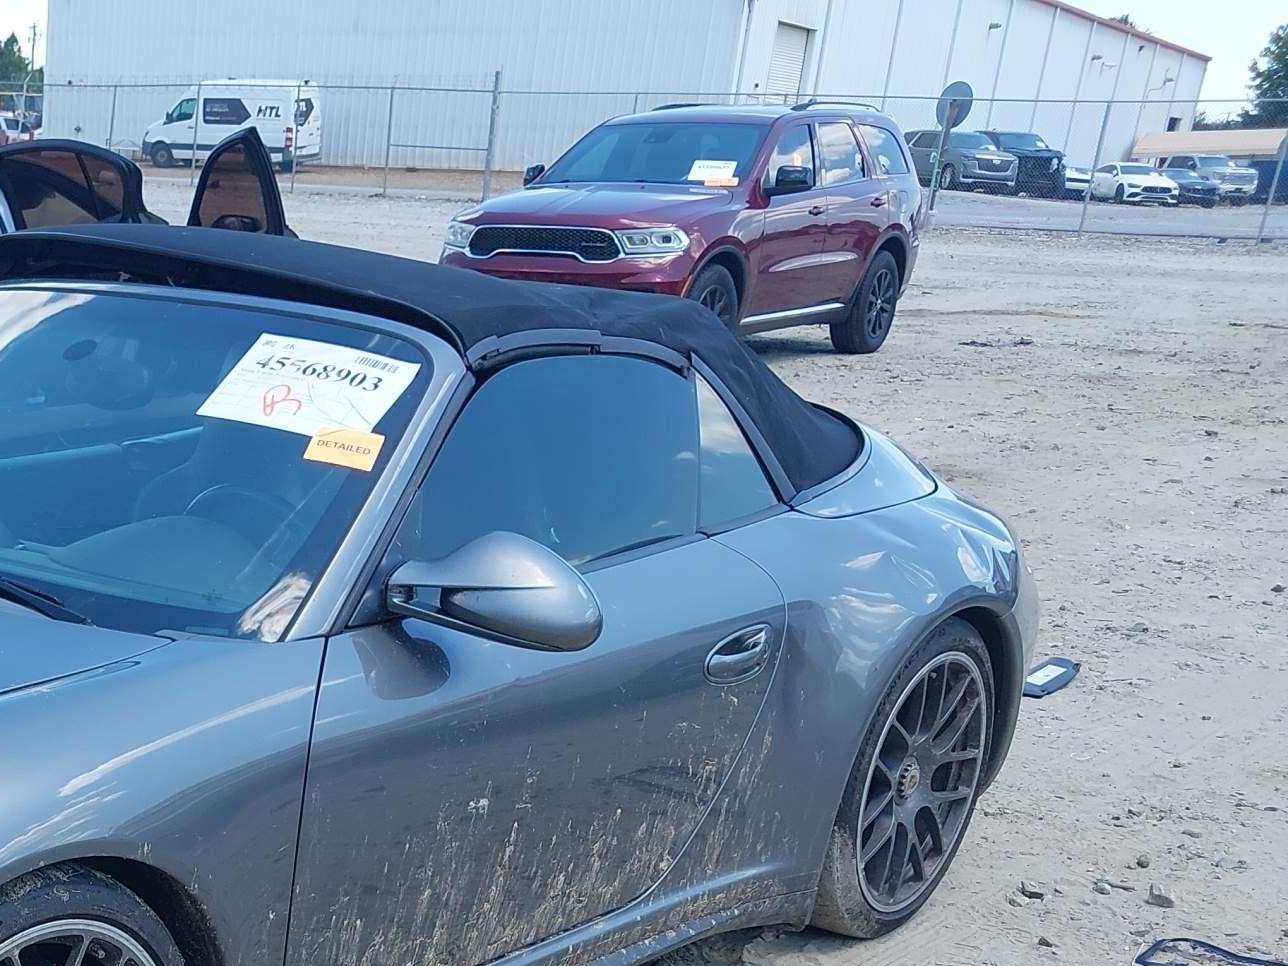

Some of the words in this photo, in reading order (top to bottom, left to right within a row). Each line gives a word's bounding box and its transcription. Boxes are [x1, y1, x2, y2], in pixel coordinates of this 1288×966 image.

[256, 105, 281, 118] HTL
[255, 355, 383, 392] 45568903
[316, 439, 372, 456] DETAILED
